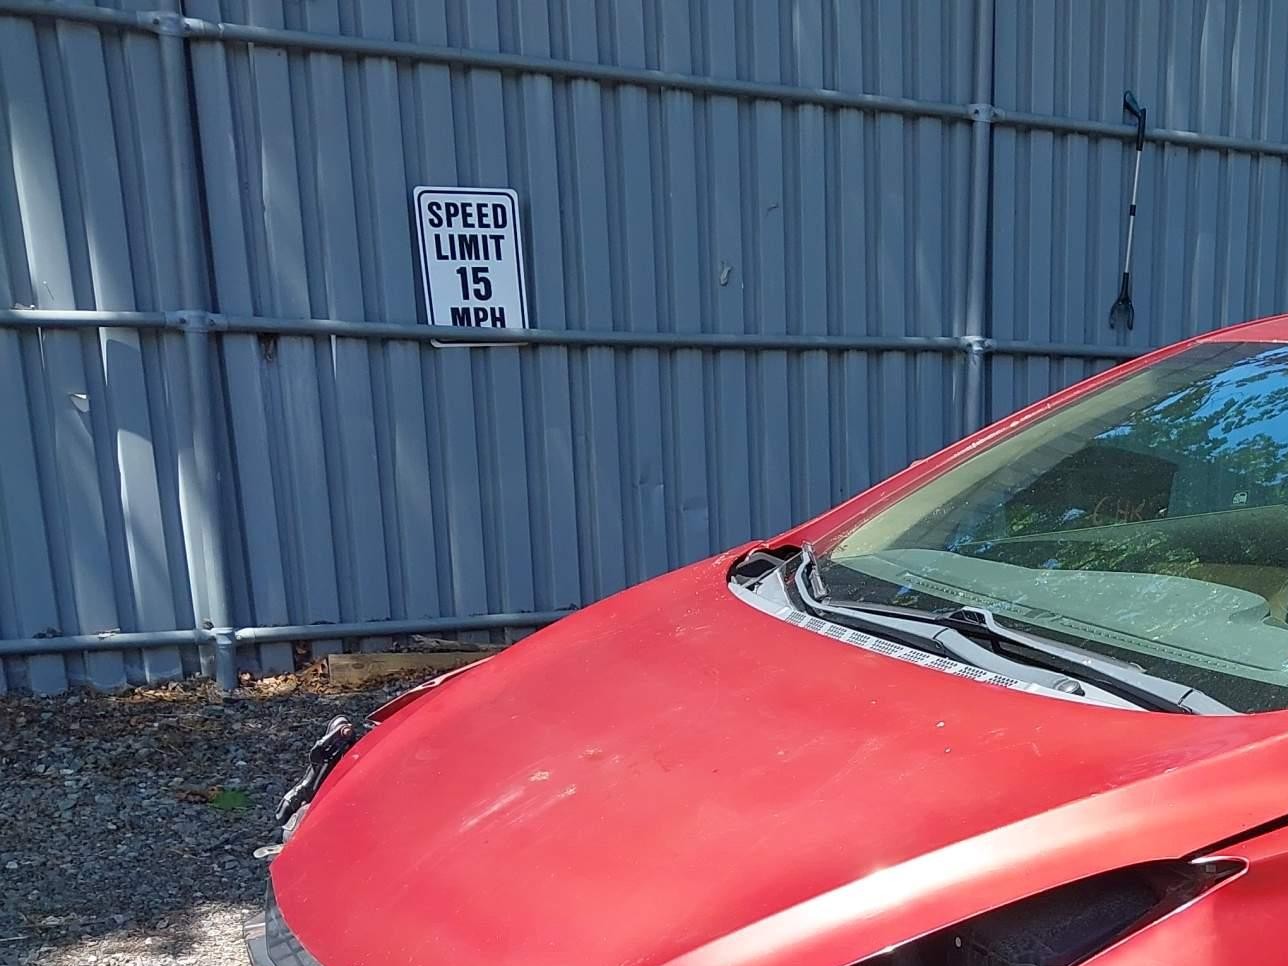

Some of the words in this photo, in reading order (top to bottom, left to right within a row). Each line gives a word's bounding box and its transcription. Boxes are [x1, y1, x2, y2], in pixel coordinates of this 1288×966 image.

[427, 201, 508, 229] SPEED
[434, 233, 505, 261] LIMIT
[456, 266, 493, 301] 15
[450, 306, 506, 329] MPH
